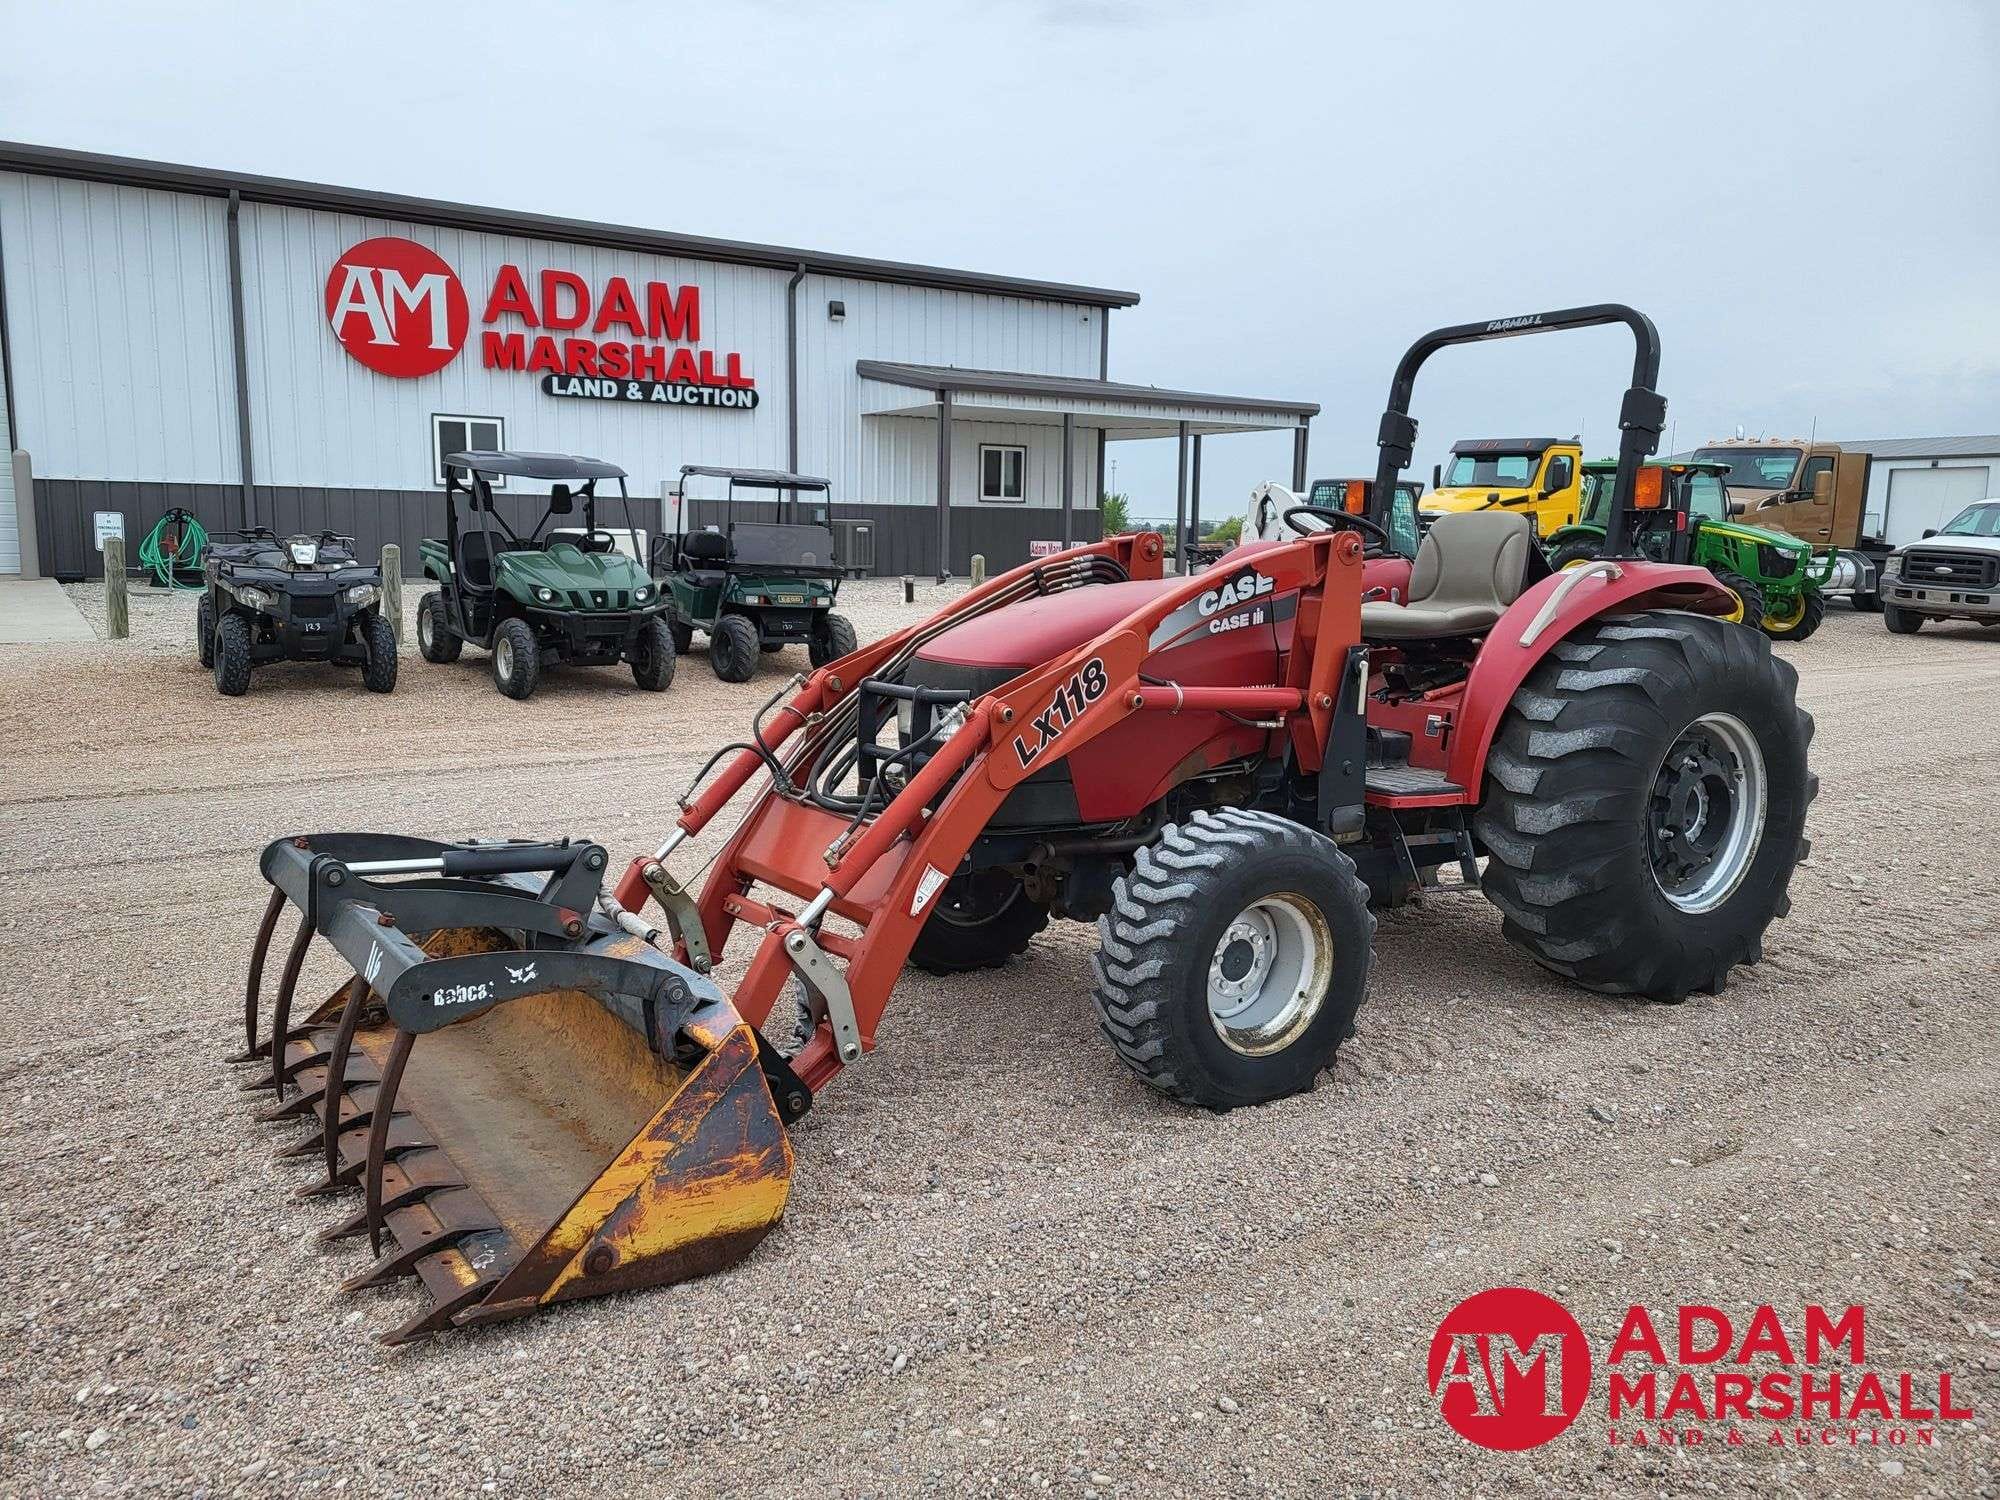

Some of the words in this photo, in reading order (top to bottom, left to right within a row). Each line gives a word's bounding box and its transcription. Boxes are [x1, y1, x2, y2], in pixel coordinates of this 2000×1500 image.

[331, 264, 454, 351] AM
[483, 264, 701, 342] ADAM
[1486, 314, 1542, 332] FARMALL
[482, 331, 755, 388] MARSHALL
[551, 376, 618, 398] LAND
[626, 381, 643, 400] &
[651, 383, 753, 408] AUCTION
[304, 622, 321, 632] 123
[1209, 613, 1250, 634] CASE
[1013, 657, 1109, 769] LX118
